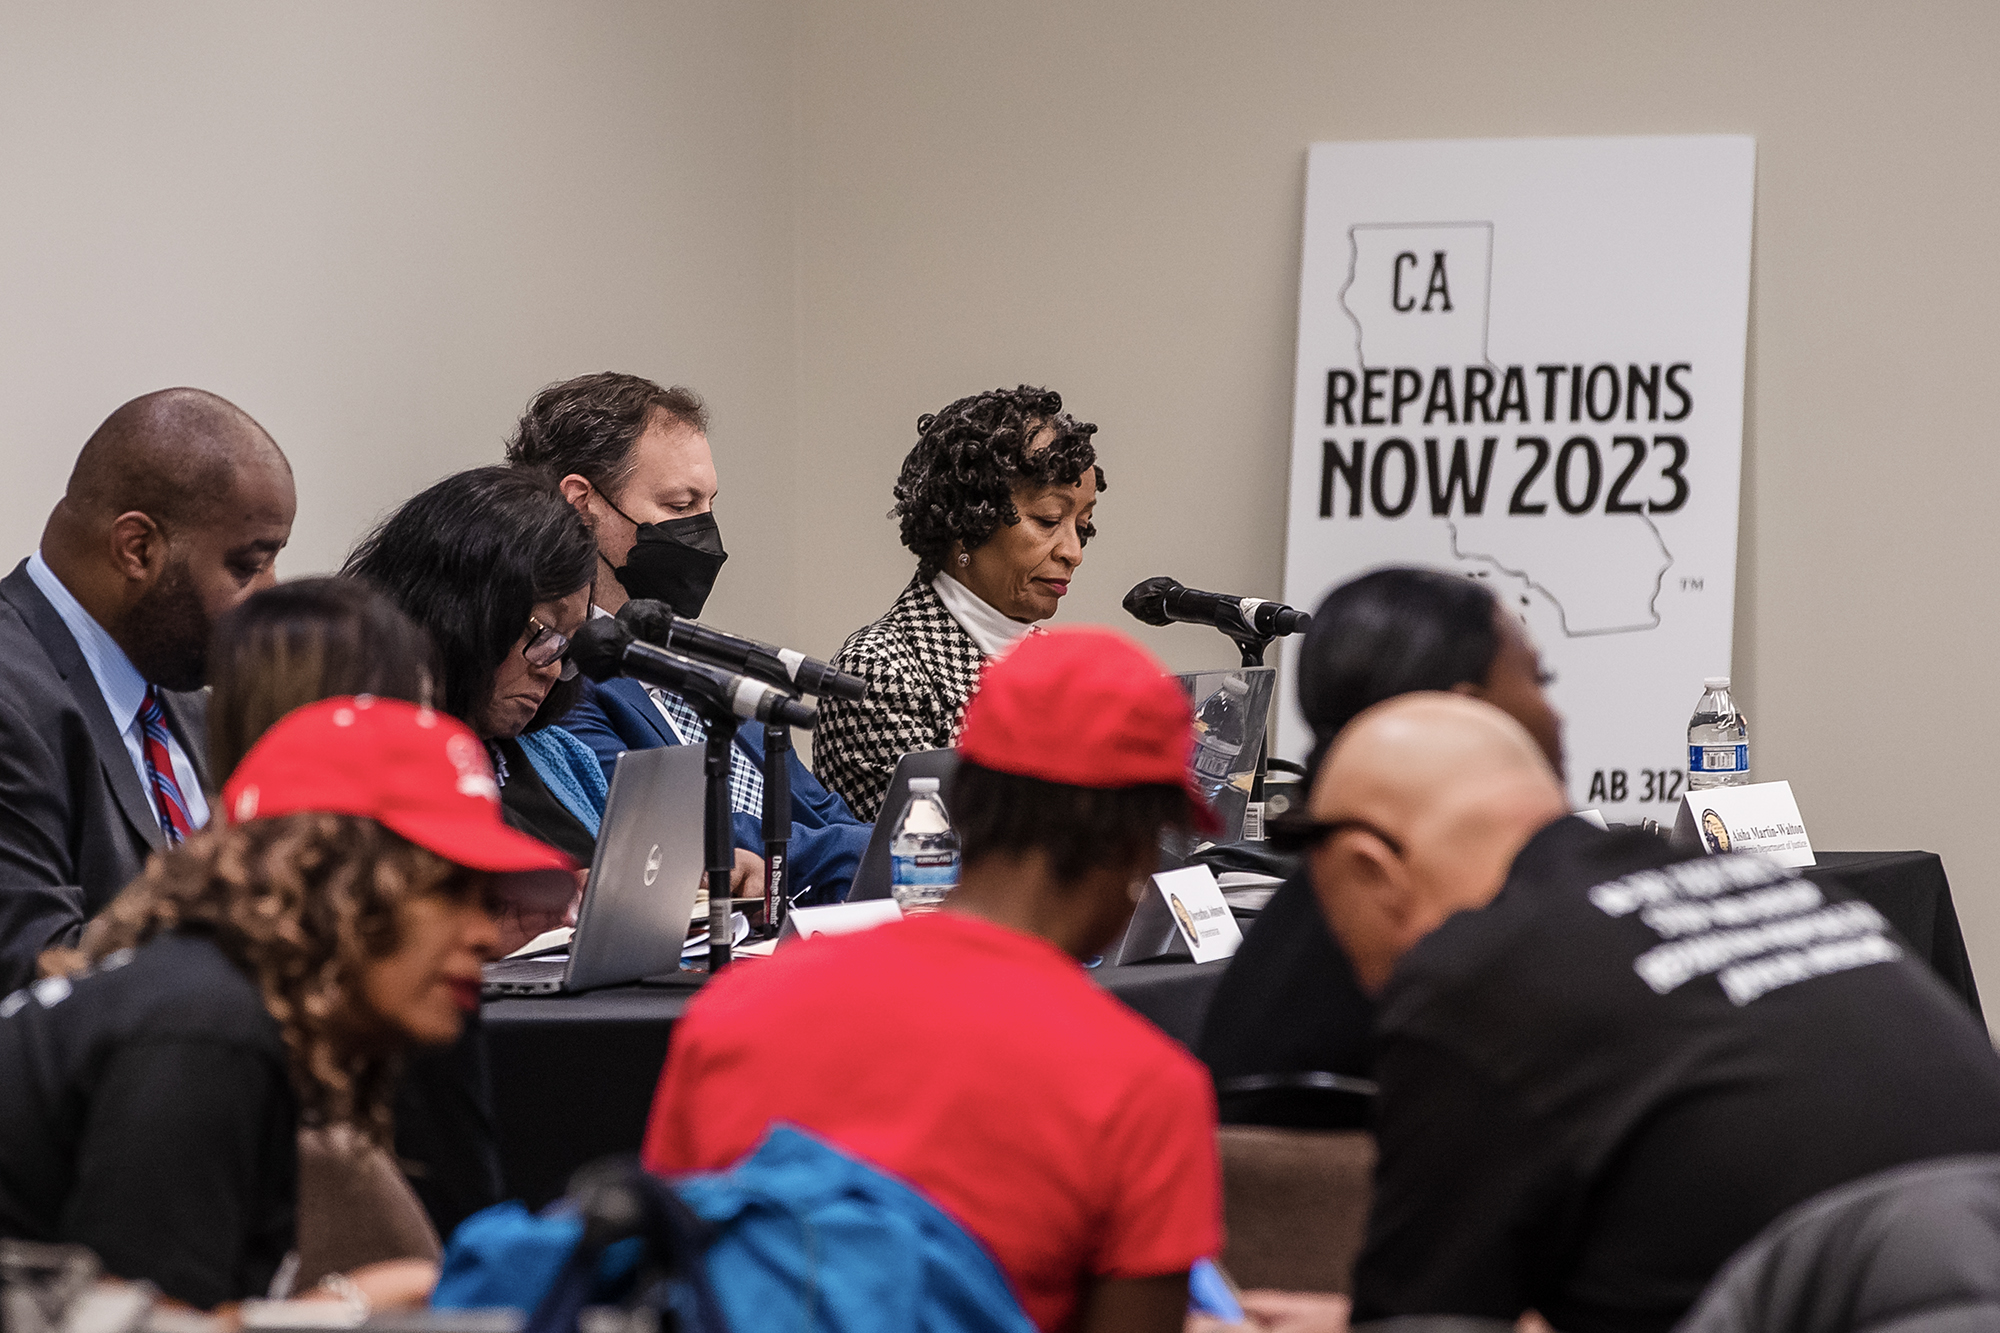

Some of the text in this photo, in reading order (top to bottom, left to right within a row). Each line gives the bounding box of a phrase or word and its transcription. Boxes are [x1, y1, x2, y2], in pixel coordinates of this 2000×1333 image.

[1391, 250, 1454, 313] CA
[1324, 361, 1693, 426] REPARATIONS
[1318, 434, 1691, 519] NOW 2023
[1588, 769, 1629, 803] AB
[1732, 822, 1804, 842] Aisha Martin-Walton
[769, 855, 782, 925] On Stage Stands
